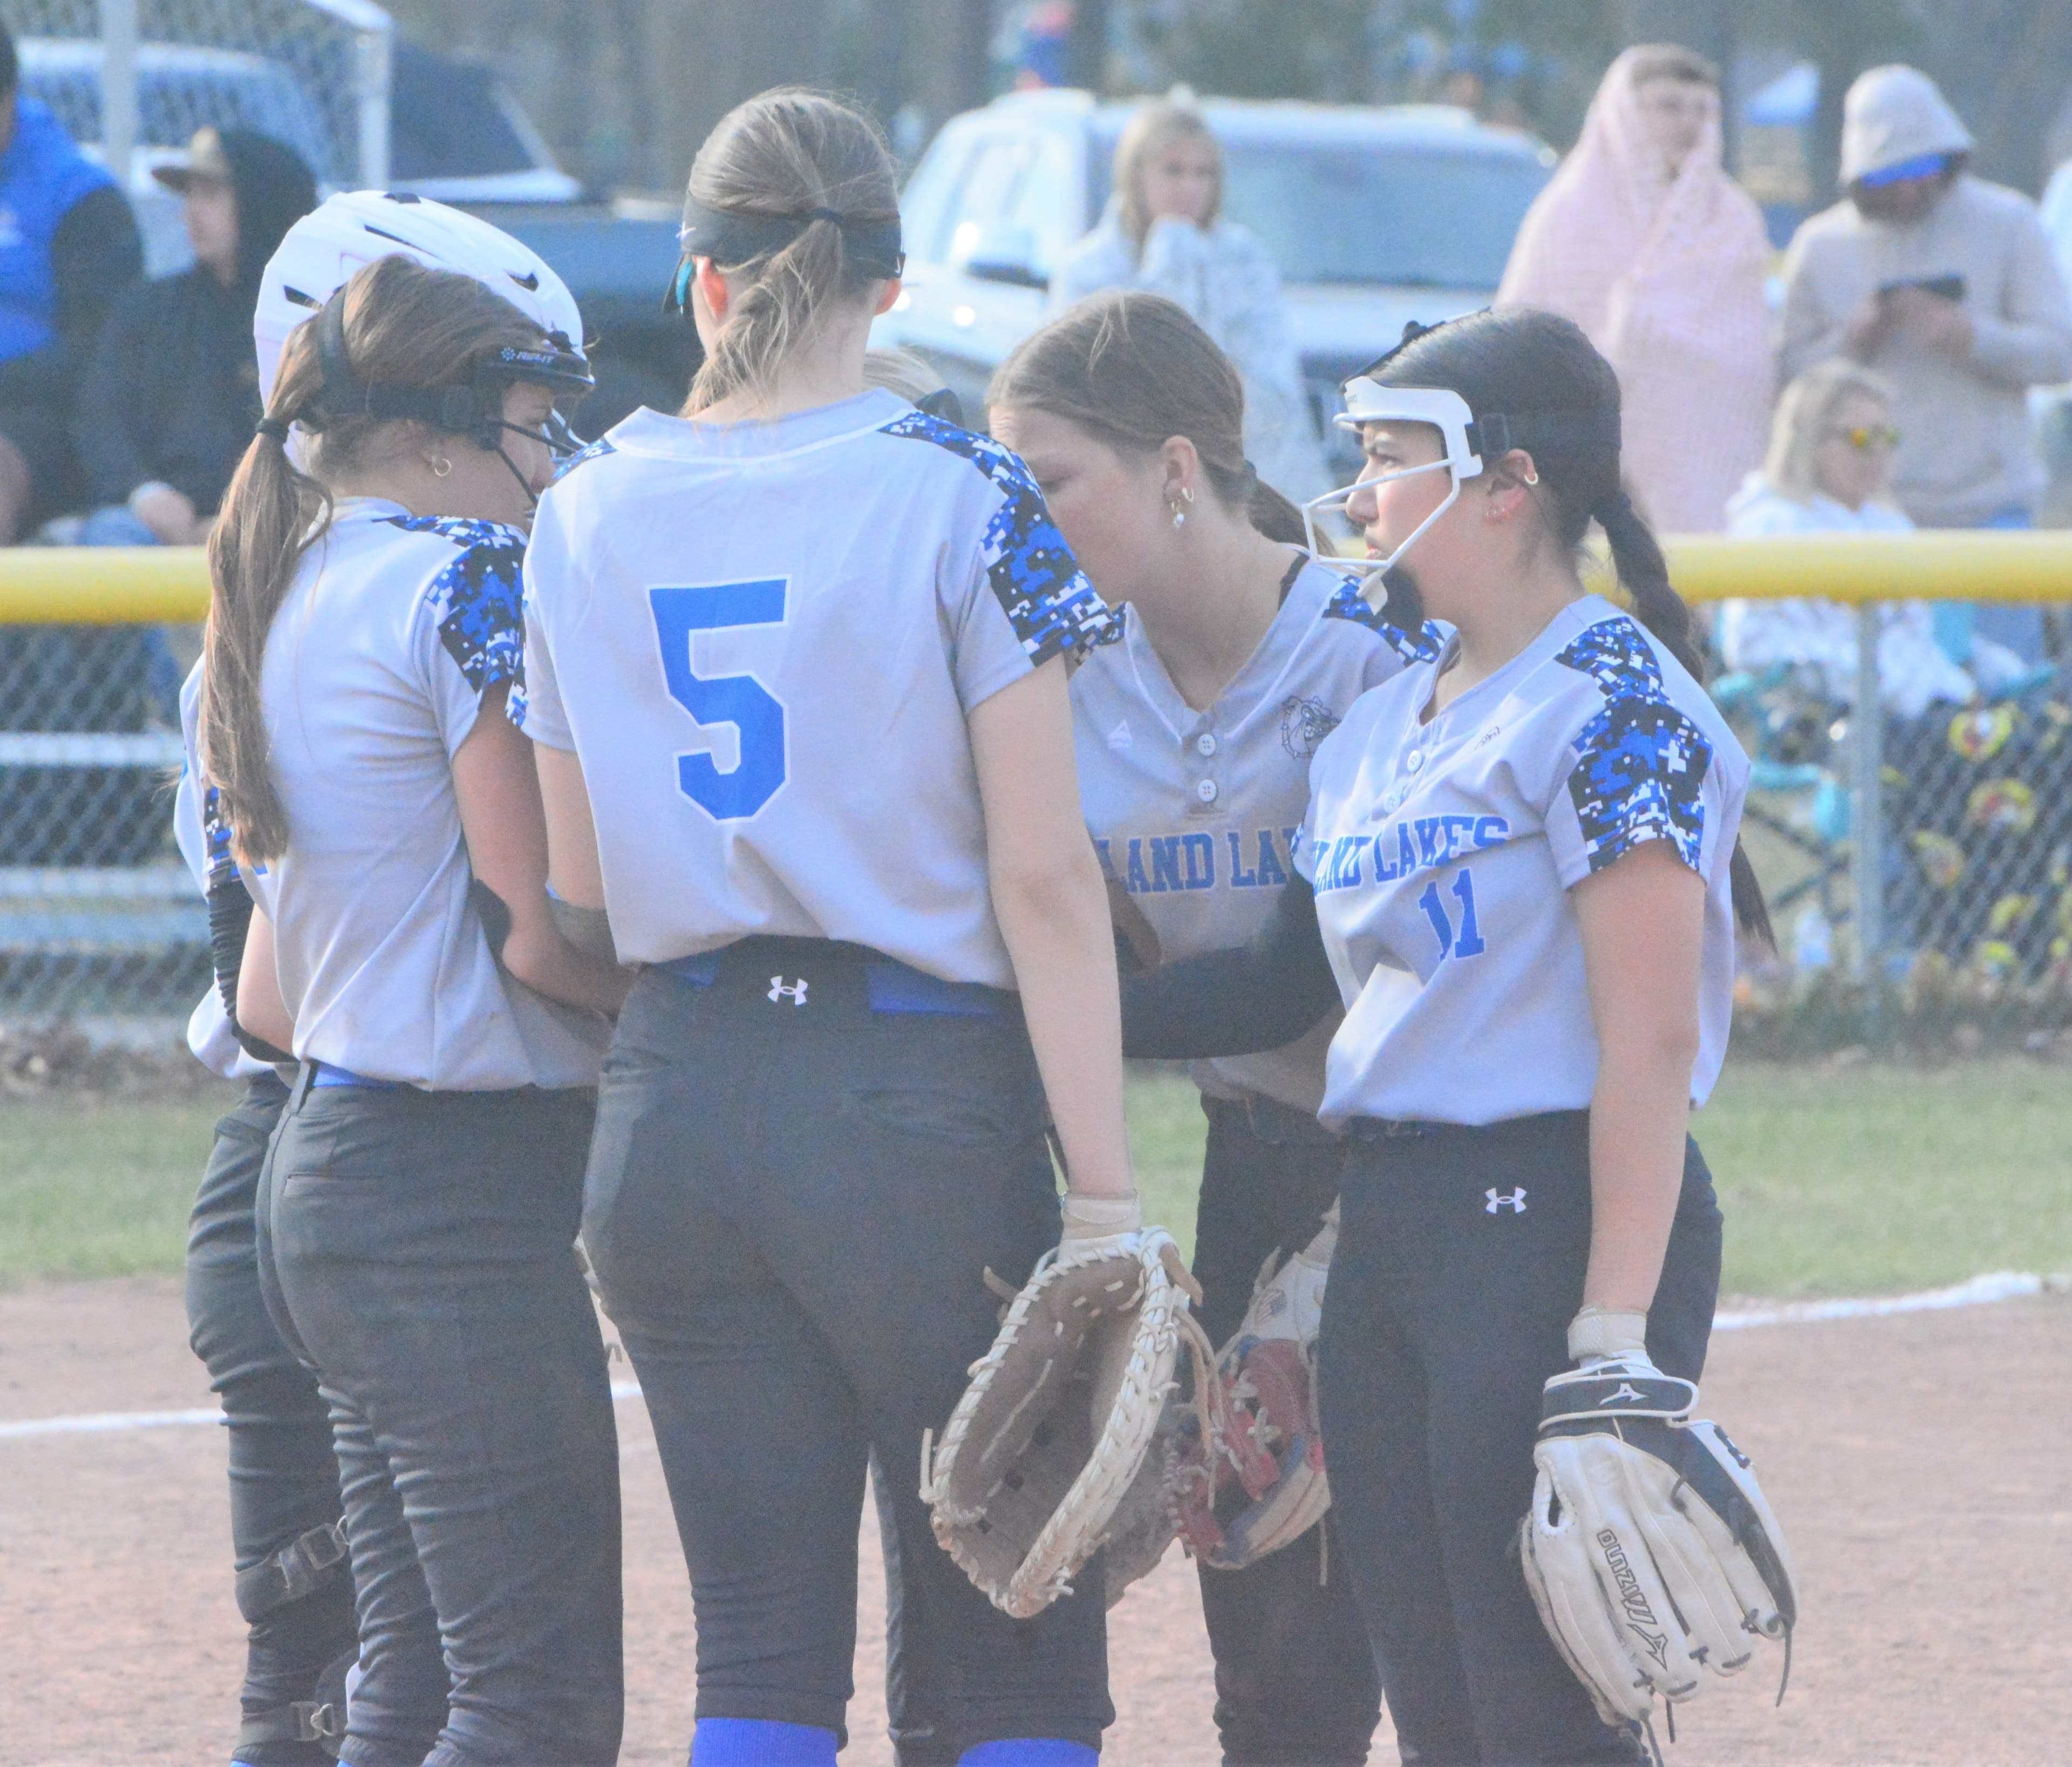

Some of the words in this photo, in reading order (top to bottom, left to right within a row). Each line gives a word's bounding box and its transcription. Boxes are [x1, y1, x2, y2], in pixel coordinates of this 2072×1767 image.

[647, 575, 791, 824] 5
[1373, 814, 1509, 883] LAKES
[1419, 867, 1485, 962] 11
